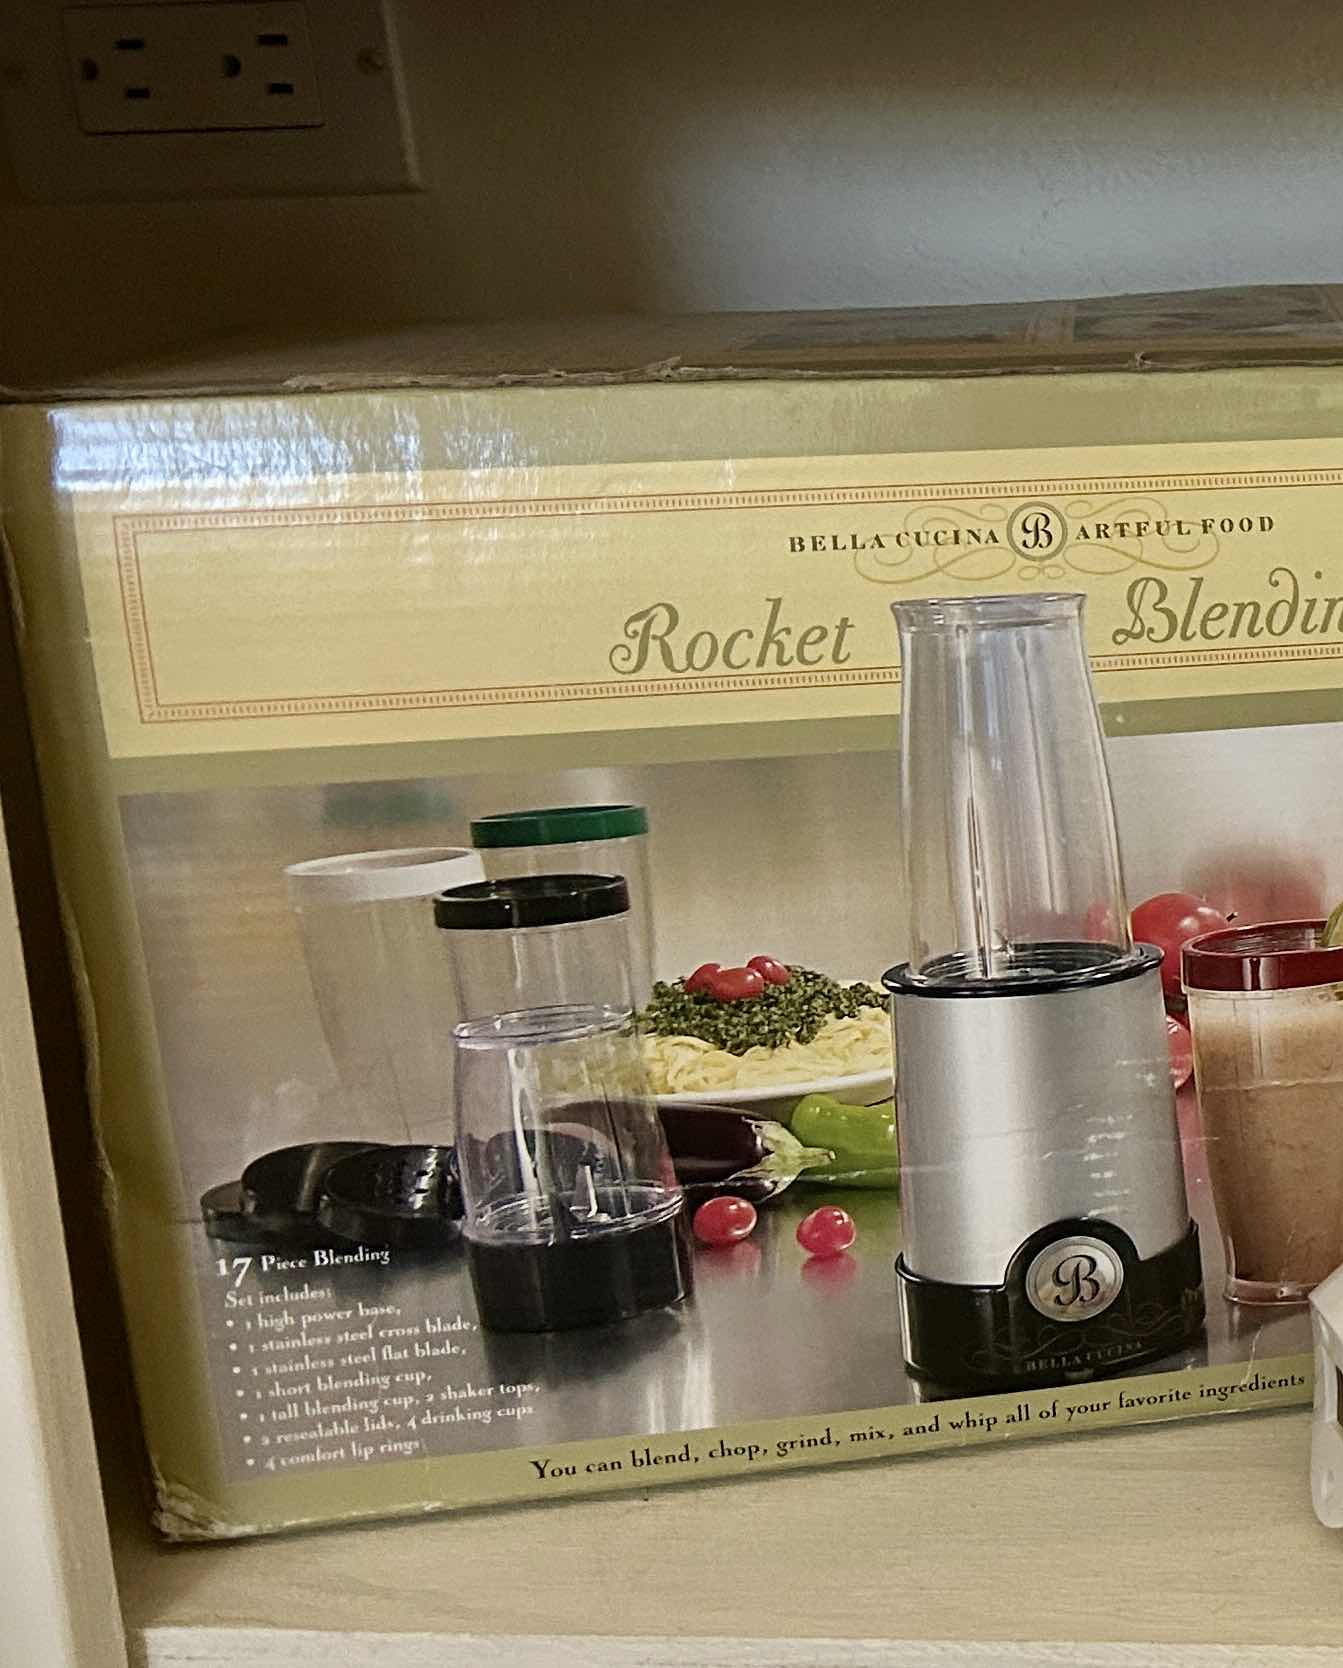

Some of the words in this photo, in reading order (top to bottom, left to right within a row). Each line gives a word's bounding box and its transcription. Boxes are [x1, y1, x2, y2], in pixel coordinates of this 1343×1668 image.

[789, 533, 886, 553] BELLA
[895, 528, 1000, 548] CUCINA
[1075, 519, 1192, 541] ARTFUL
[1201, 515, 1275, 535] FOOD
[609, 598, 855, 675] Rocket
[216, 1257, 253, 1287] 17
[261, 1254, 308, 1272] Piece
[314, 1245, 390, 1266] Blending
[225, 1290, 253, 1308] Set
[257, 1310, 295, 1332] high
[301, 1309, 353, 1329] power
[358, 1302, 401, 1317] base,
[262, 1331, 331, 1352] stainless
[337, 1323, 373, 1341] steel
[379, 1326, 420, 1339] cross
[425, 1315, 479, 1334] blade,
[266, 1354, 334, 1374] stainless
[340, 1346, 377, 1366] steel
[382, 1345, 409, 1361] flat
[415, 1340, 467, 1358] blade,
[1025, 1354, 1083, 1372] BELLA
[269, 1381, 311, 1398] short
[317, 1371, 391, 1391] blending
[395, 1370, 432, 1385] cup,
[272, 1403, 299, 1421] tall
[304, 1396, 379, 1416] blending
[384, 1396, 420, 1409] cup,
[440, 1383, 495, 1400] shaker
[500, 1383, 541, 1398] tops,
[276, 1420, 360, 1443] resealable
[407, 1416, 416, 1430] 4
[421, 1406, 492, 1425] drinking
[530, 1458, 578, 1481] You
[585, 1456, 623, 1474] can
[631, 1443, 699, 1469] blend,
[708, 1439, 769, 1461] chop,
[776, 1428, 841, 1458] grind,
[849, 1426, 895, 1443] mix,
[903, 1415, 940, 1436] and
[949, 1408, 998, 1432] whip
[1005, 1404, 1030, 1425] all
[1038, 1400, 1059, 1420] of
[1066, 1397, 1112, 1422] your
[1118, 1388, 1192, 1410] favorite
[1199, 1372, 1306, 1402] ingredients
[264, 1457, 275, 1471] 4
[280, 1447, 346, 1467] comfort
[352, 1441, 374, 1461] lip
